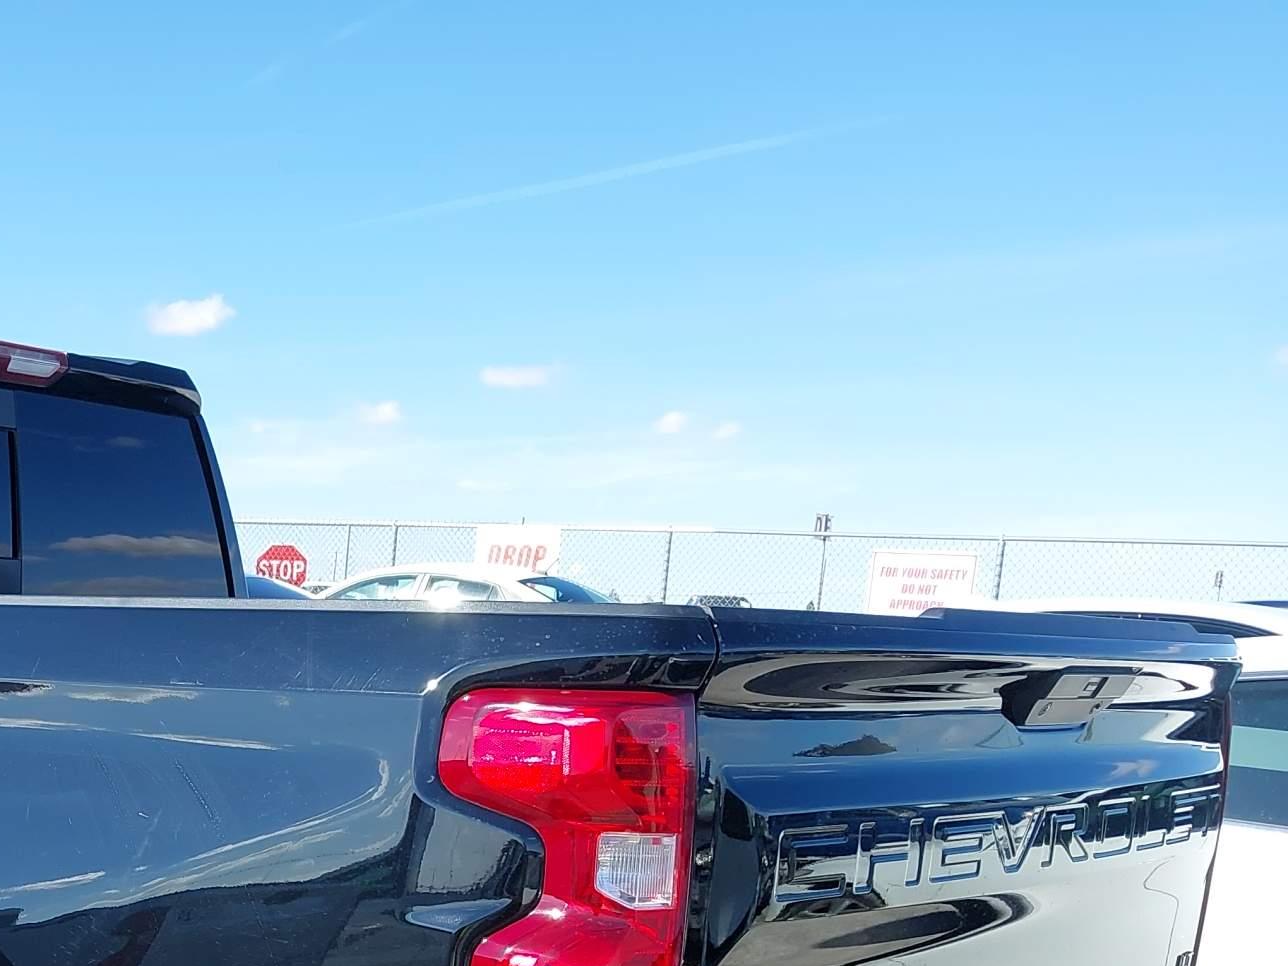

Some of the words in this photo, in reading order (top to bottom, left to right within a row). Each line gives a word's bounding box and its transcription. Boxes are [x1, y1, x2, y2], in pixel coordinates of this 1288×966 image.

[487, 544, 547, 569] DROP
[257, 560, 305, 580] STOP
[880, 566, 900, 578] FOR
[902, 567, 928, 580] YOUR
[929, 569, 968, 581] SAFETY
[901, 583, 915, 595] DO
[917, 584, 939, 596] NOT
[775, 783, 1221, 902] CHEVROLET
